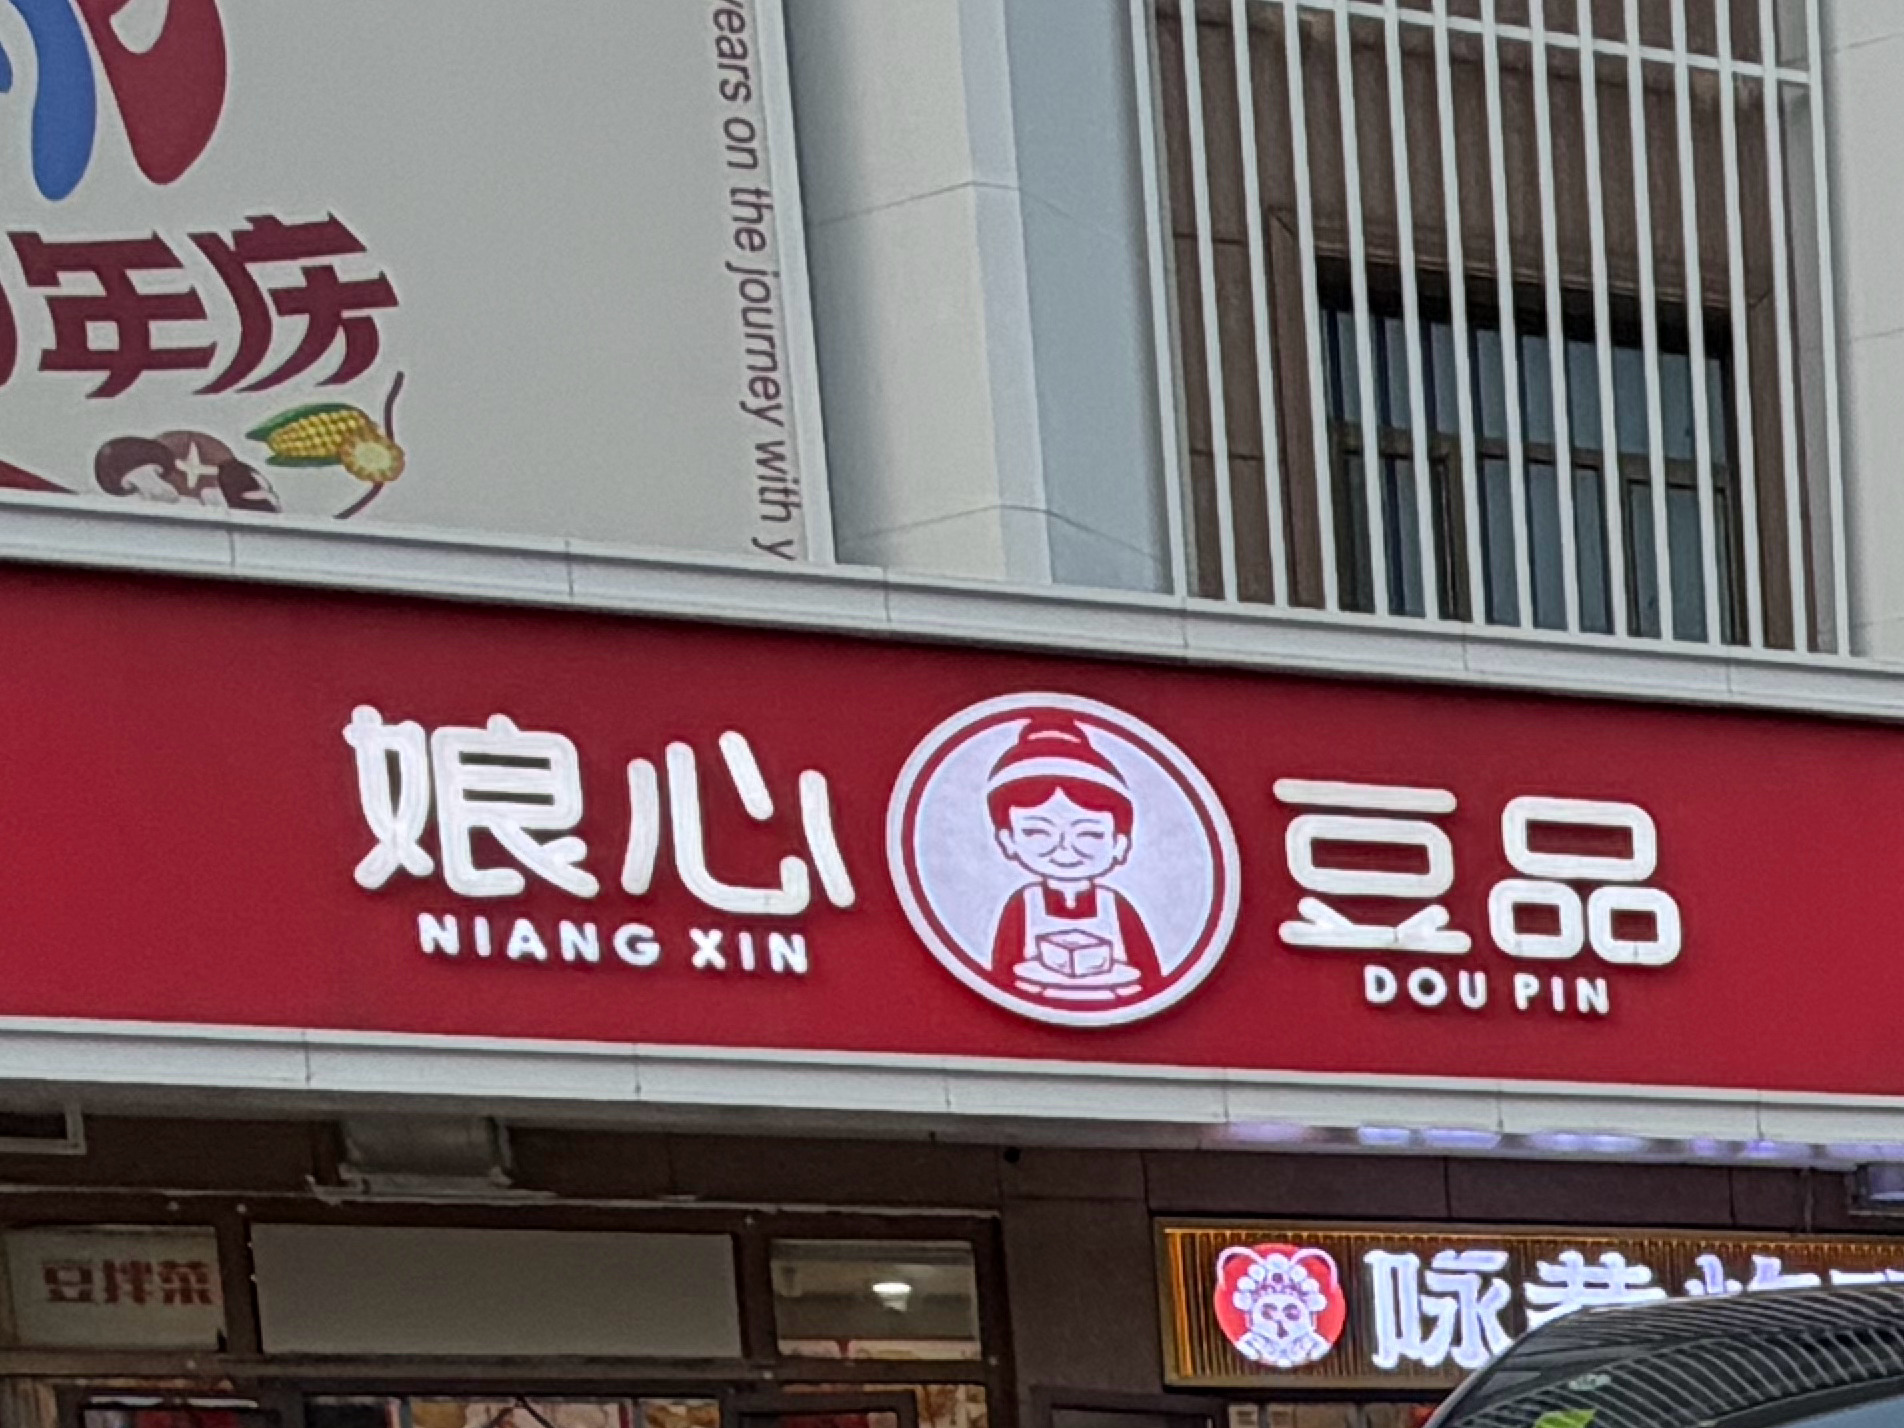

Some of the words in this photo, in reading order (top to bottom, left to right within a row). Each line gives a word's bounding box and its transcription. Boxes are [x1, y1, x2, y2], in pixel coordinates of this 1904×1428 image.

[723, 116, 758, 170] on
[730, 187, 773, 253] the
[0, 212, 400, 399] 年庆
[725, 260, 784, 427] journey
[755, 440, 803, 523] with
[342, 703, 856, 917] 娘心
[1272, 777, 1683, 967] 豆品
[417, 911, 661, 967] NIANG
[689, 927, 809, 975] XIN
[1364, 963, 1489, 1009] DOU
[1514, 970, 1611, 1015] PIN
